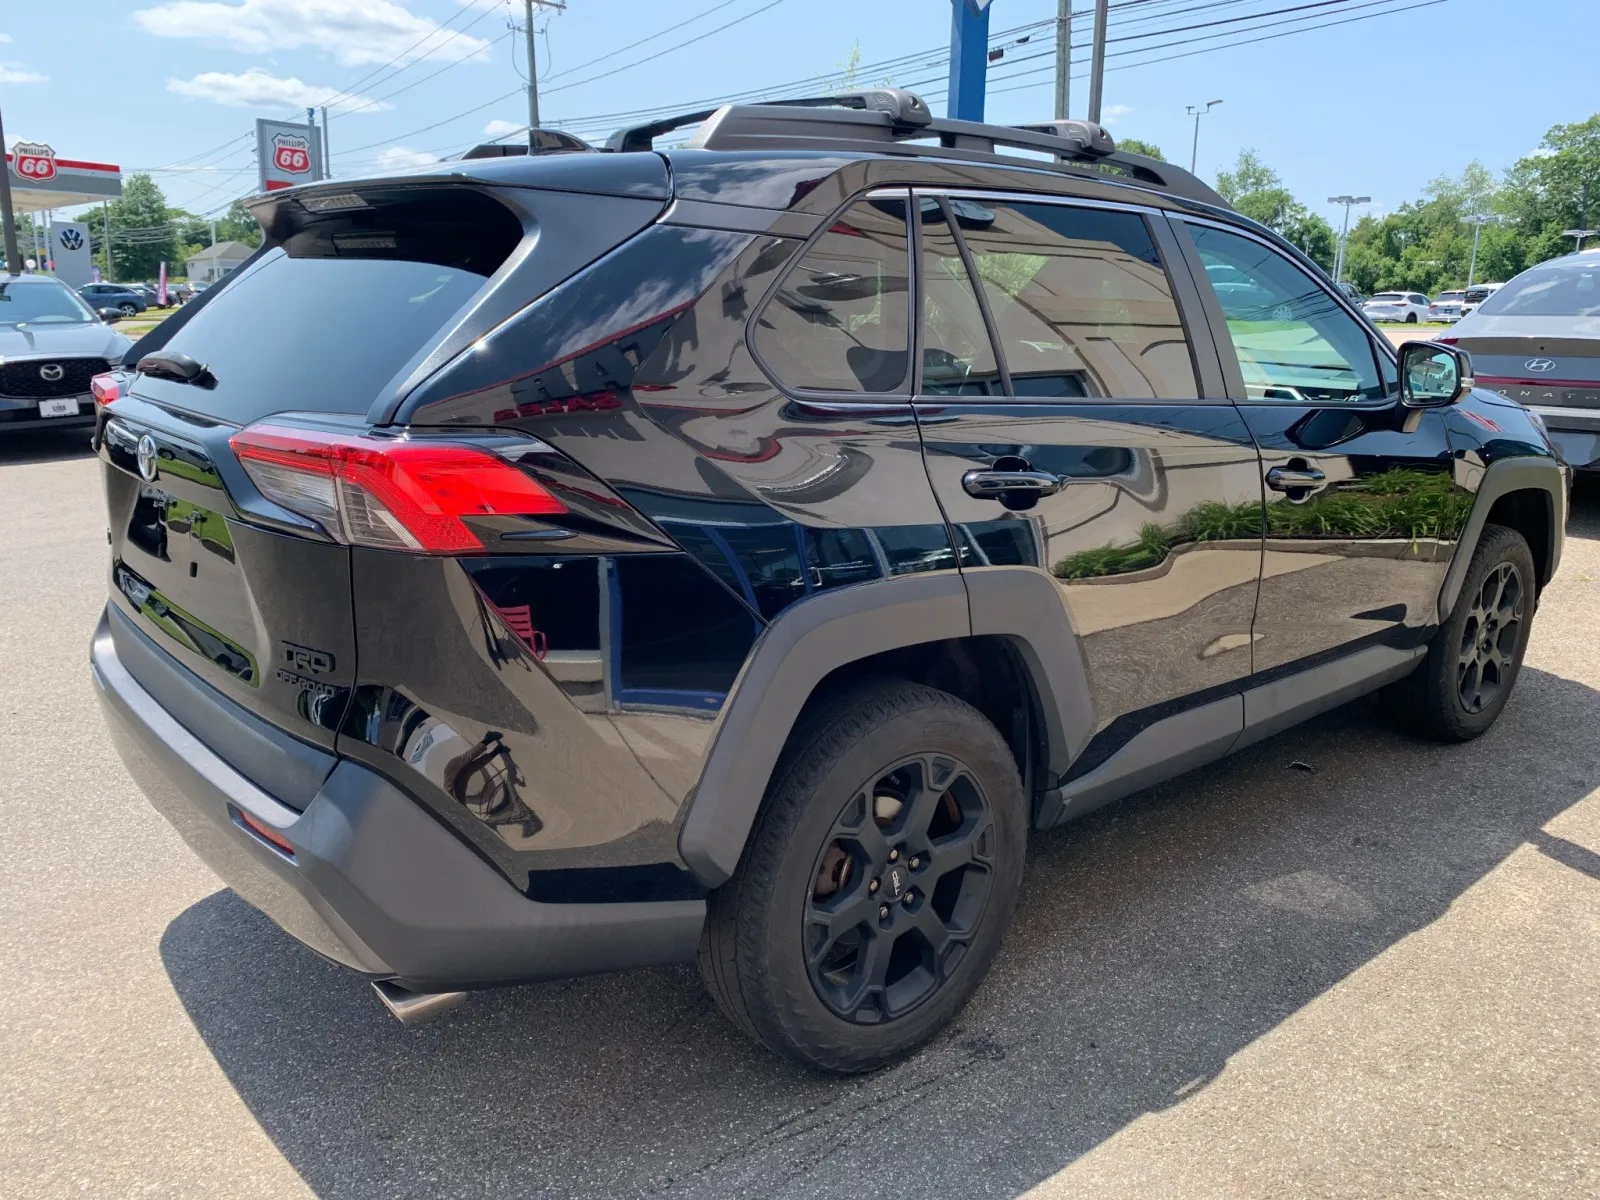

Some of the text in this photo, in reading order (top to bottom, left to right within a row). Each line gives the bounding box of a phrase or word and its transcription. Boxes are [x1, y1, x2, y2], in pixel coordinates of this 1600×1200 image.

[19, 147, 50, 157] PHILLIPS
[277, 139, 306, 149] PHILLIPS
[22, 158, 49, 174] 66
[280, 150, 305, 167] 66
[282, 640, 336, 674] TRD
[892, 870, 901, 896] TRD
